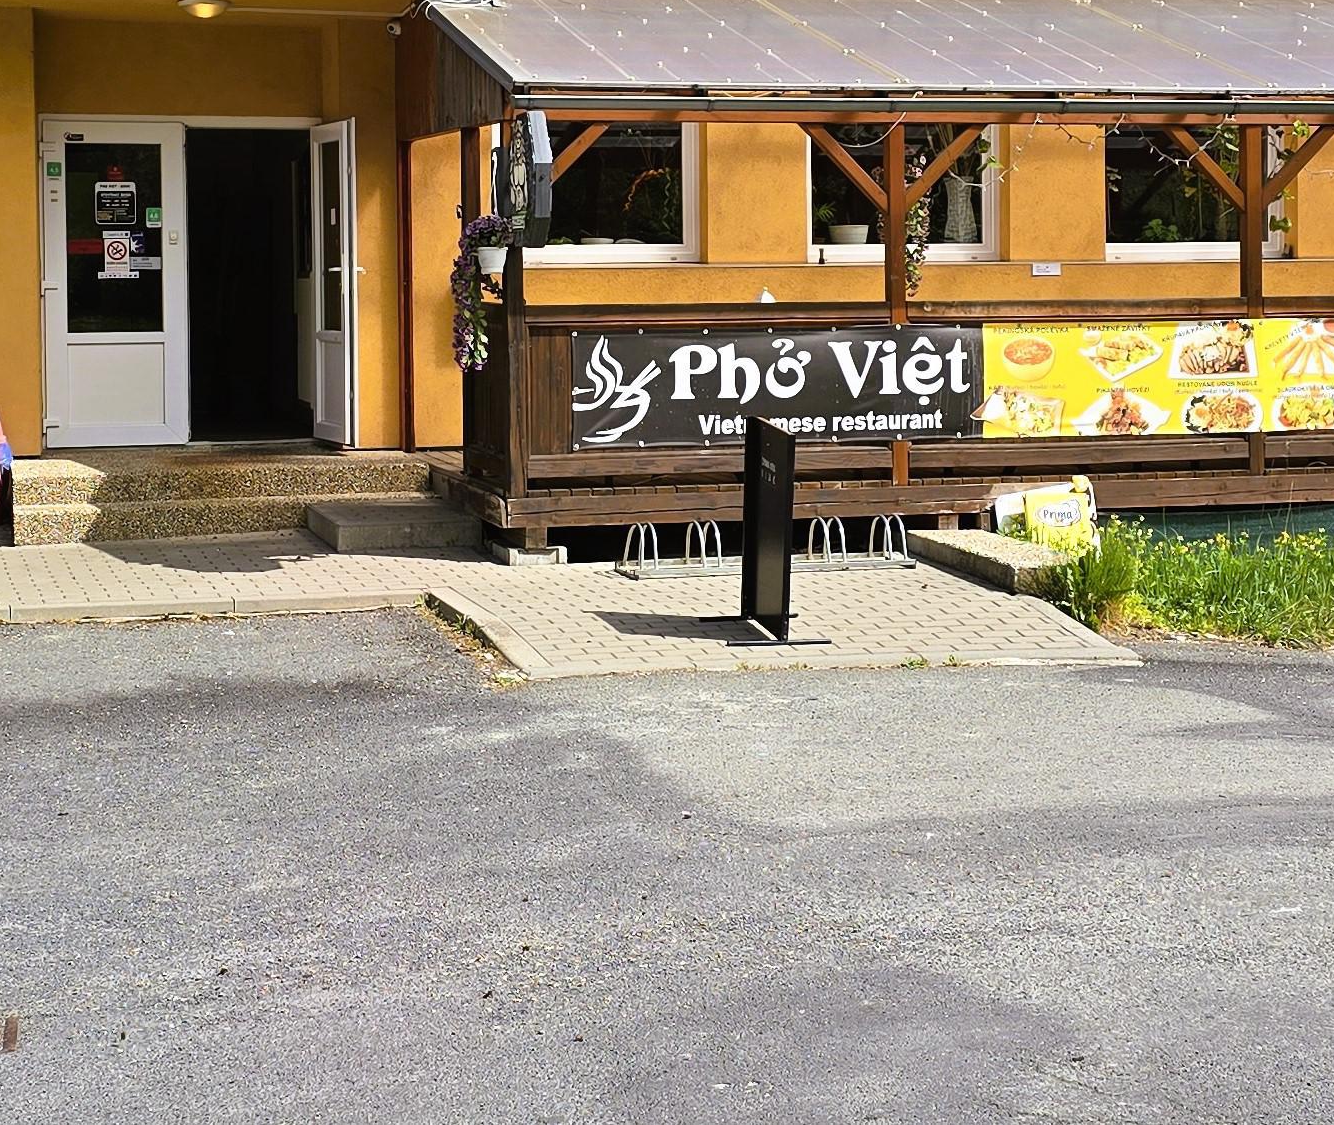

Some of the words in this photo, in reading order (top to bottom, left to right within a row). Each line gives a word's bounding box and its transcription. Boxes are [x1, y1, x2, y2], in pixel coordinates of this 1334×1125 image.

[668, 337, 812, 405] Phở
[827, 336, 971, 406] Việt
[698, 412, 826, 435] Vietmese
[832, 410, 943, 432] restaurant
[1043, 509, 1073, 521] Prima
